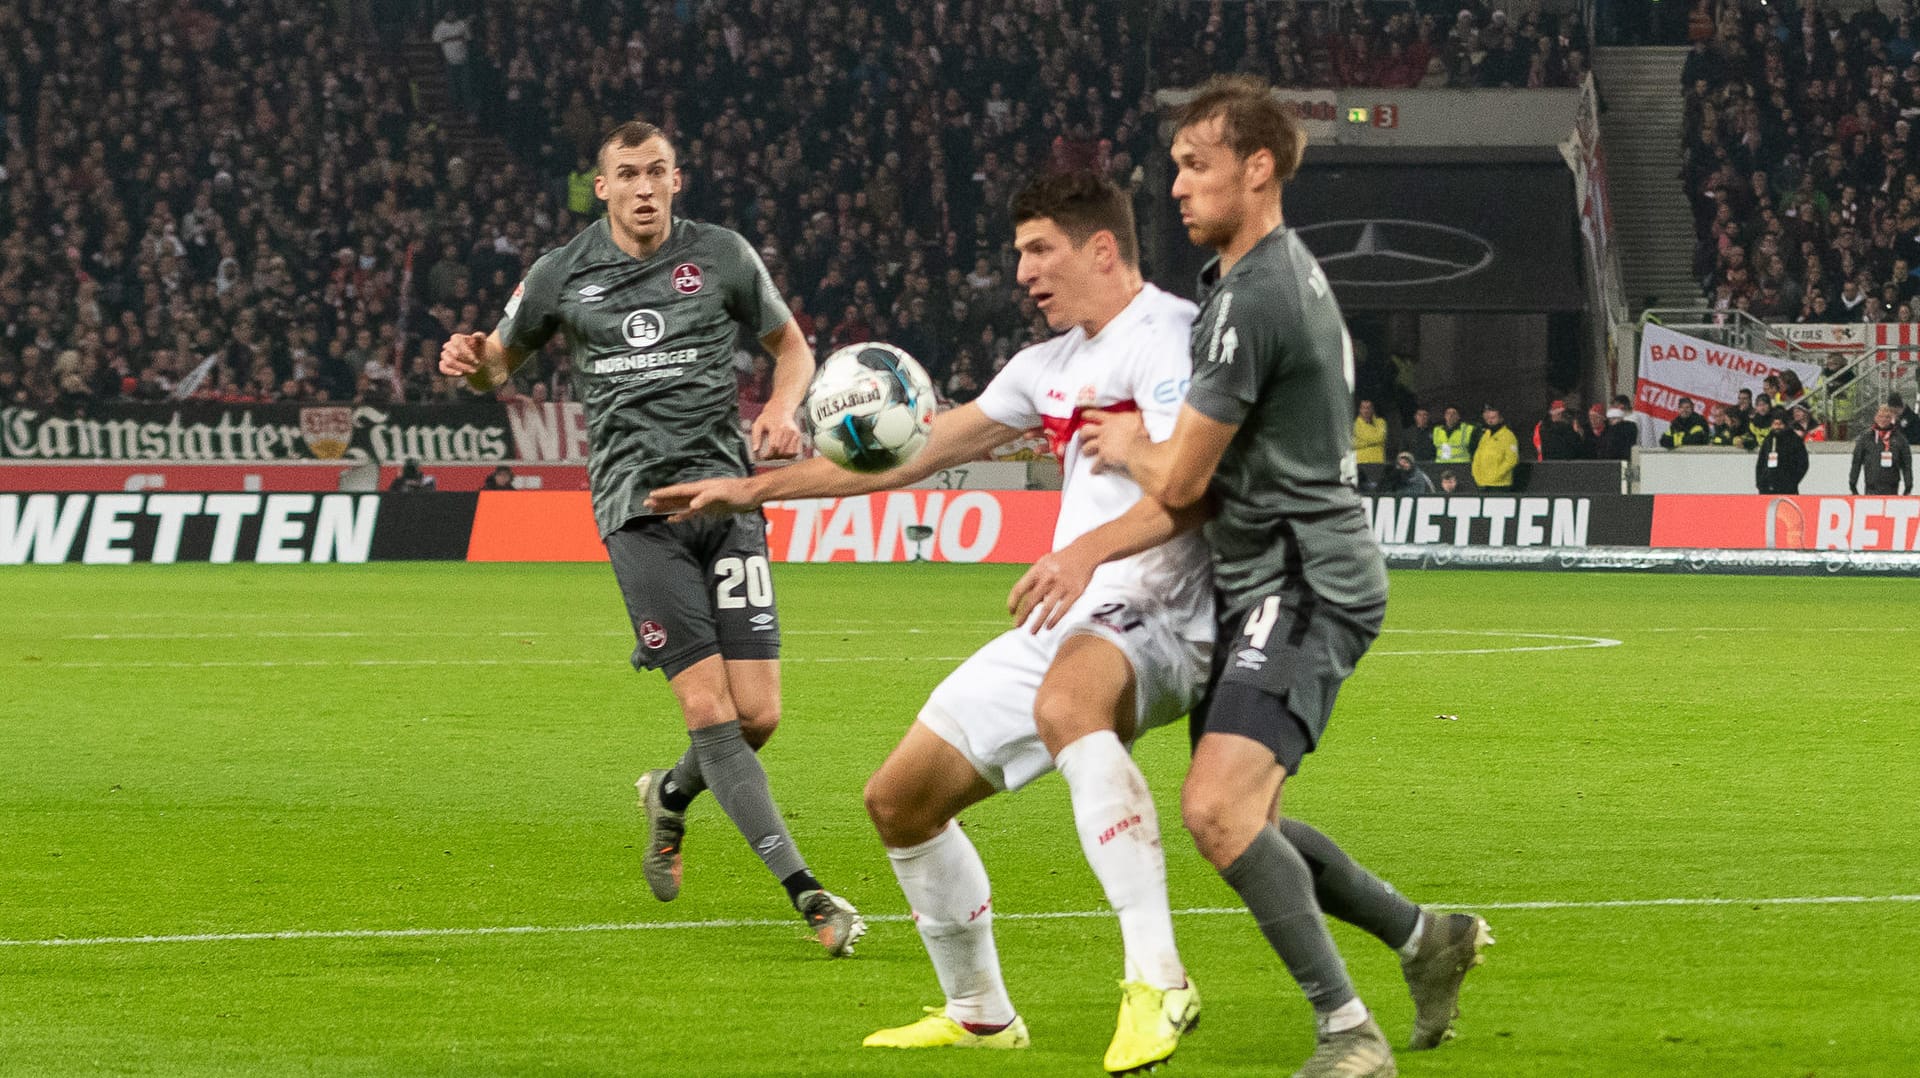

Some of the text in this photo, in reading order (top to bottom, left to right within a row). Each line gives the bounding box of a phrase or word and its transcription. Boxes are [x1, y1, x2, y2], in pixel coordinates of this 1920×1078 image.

[1379, 105, 1393, 128] 3
[1650, 344, 1697, 362] BAD
[1640, 385, 1705, 415] STAUR
[2, 406, 303, 460] Cannstatter
[936, 470, 969, 490] 37
[0, 493, 380, 564] WETTEN
[762, 491, 1002, 563] TANO
[1361, 496, 1590, 547] WETTEN
[1815, 498, 1920, 551] BET
[714, 555, 773, 610] 20
[1243, 595, 1282, 650] 4
